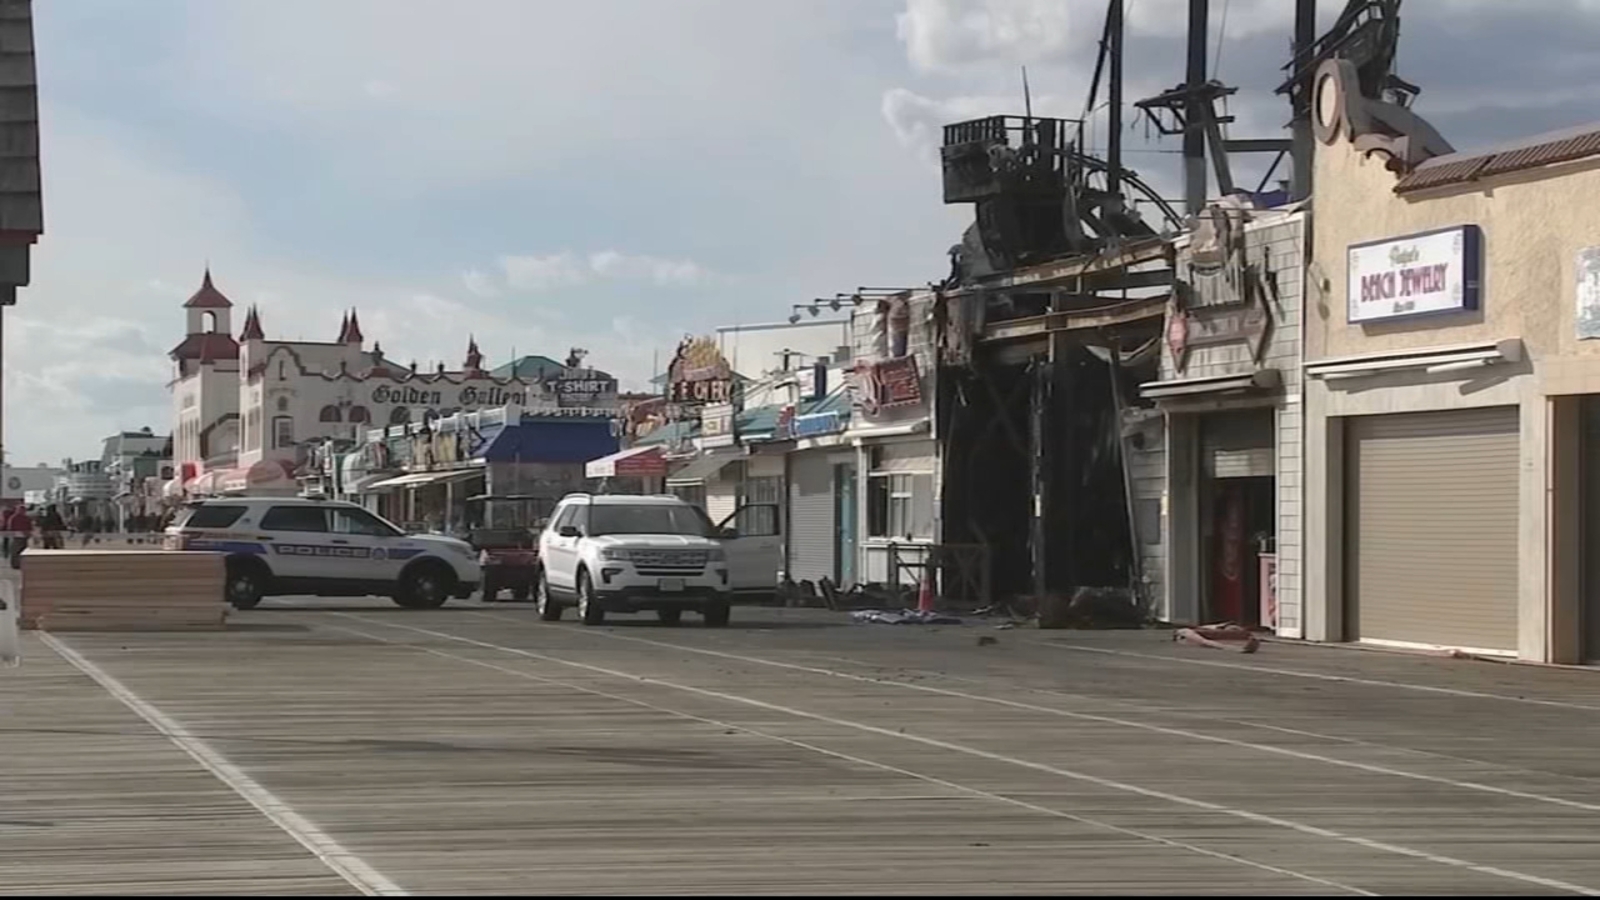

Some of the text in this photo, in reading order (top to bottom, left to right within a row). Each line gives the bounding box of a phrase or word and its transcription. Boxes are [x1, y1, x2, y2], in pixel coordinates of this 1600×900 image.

[1361, 263, 1448, 302] BEACH JEWELRY
[371, 384, 441, 405] Golden
[546, 379, 609, 393] T-SHIRT
[278, 545, 368, 557] POLICE
